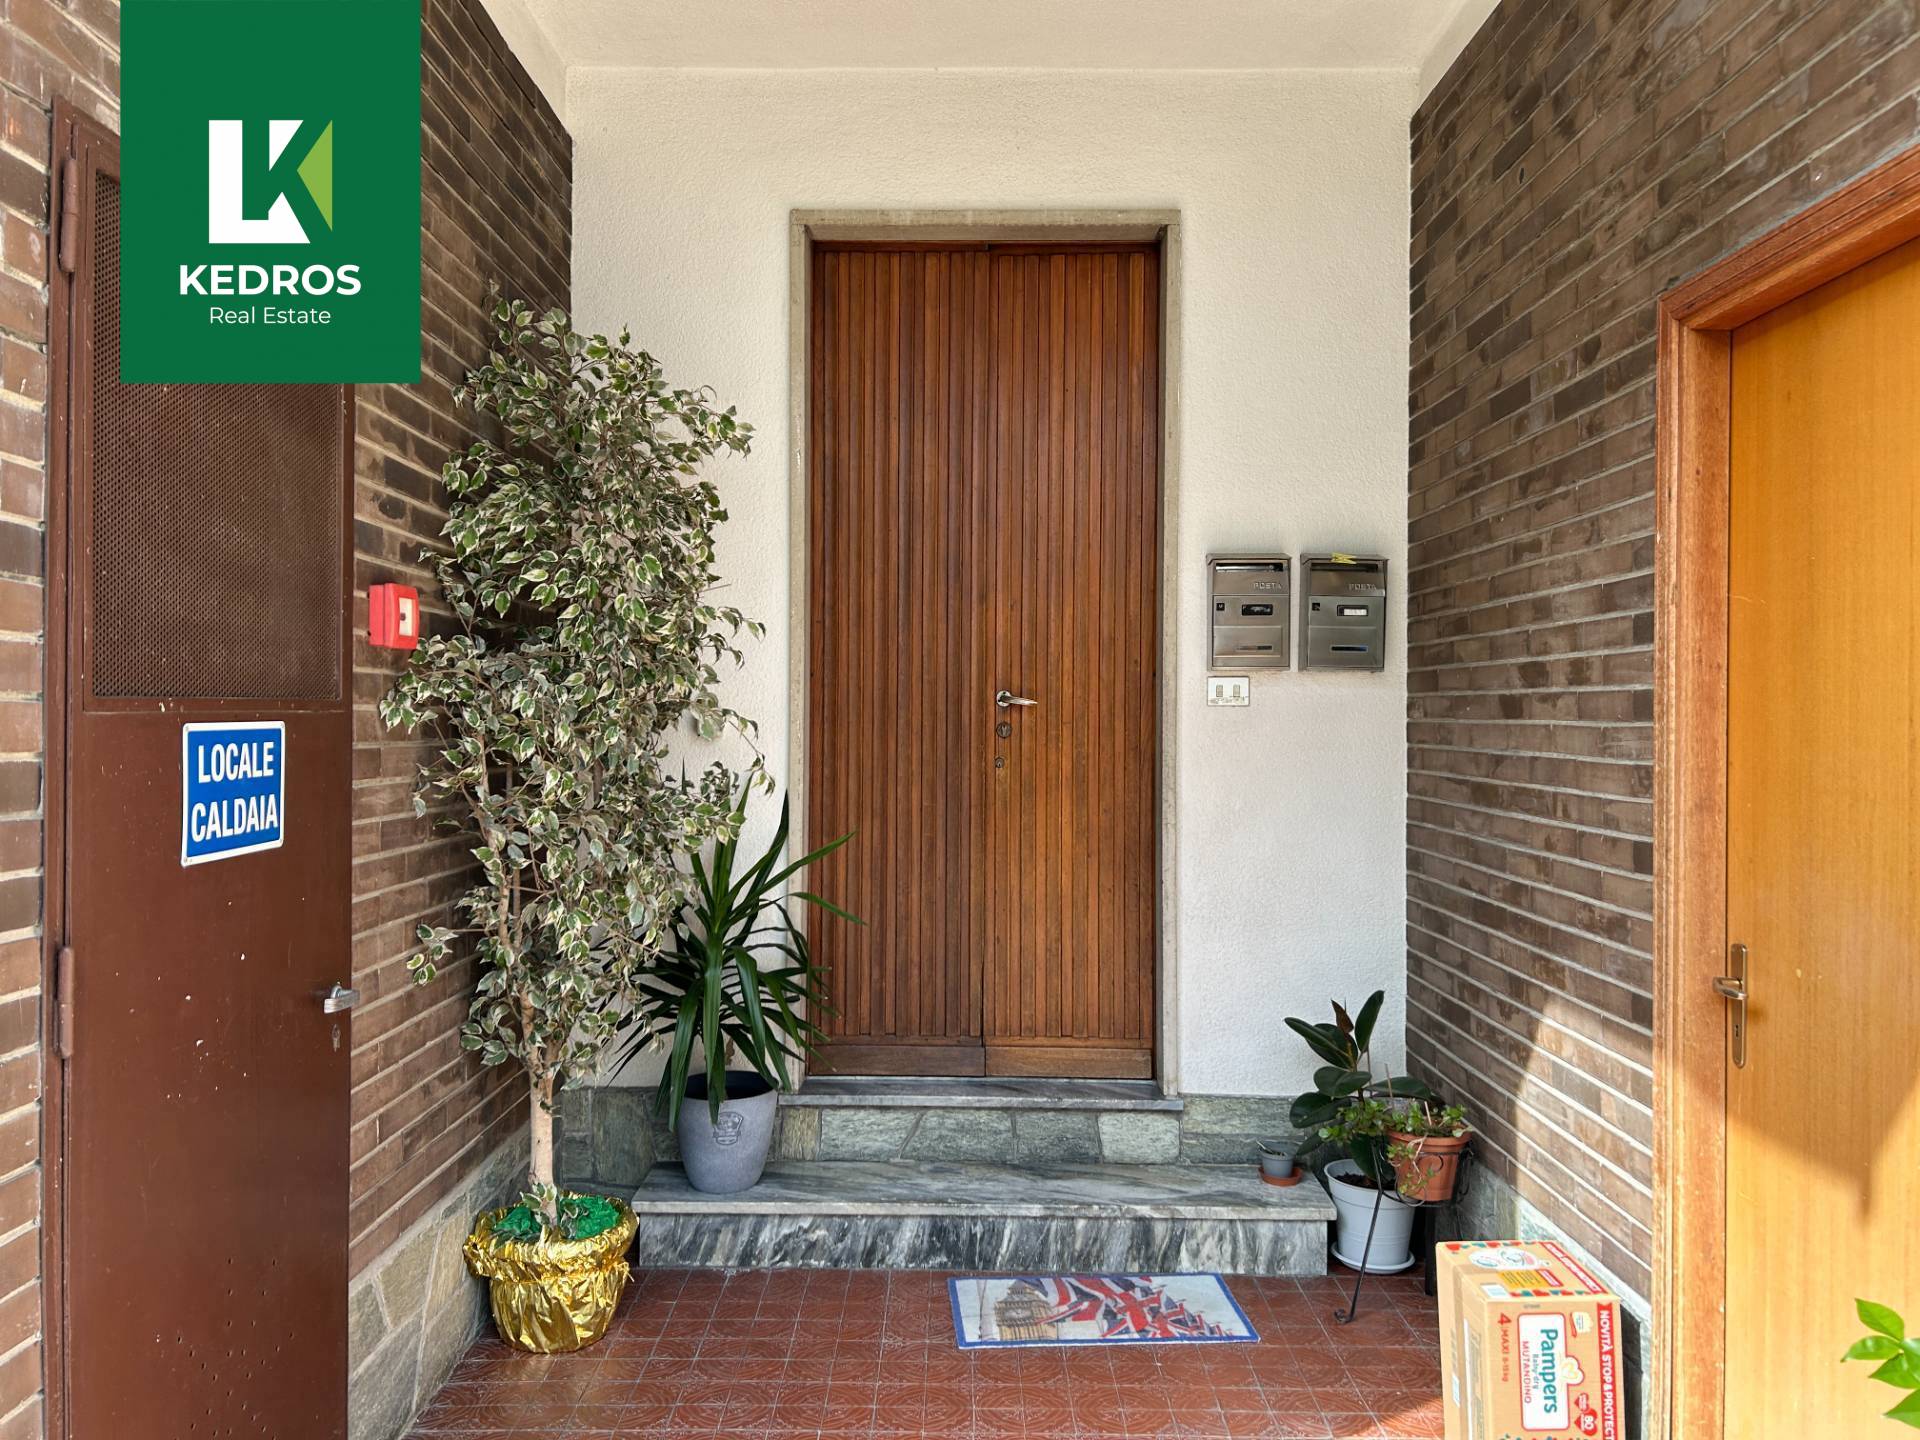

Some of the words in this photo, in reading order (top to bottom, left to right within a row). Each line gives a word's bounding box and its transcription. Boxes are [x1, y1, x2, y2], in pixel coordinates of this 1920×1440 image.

[1253, 582, 1282, 590] POSTA
[198, 741, 275, 784] LOCALE
[191, 794, 278, 842] CALDAIA
[1497, 1312, 1512, 1326] 4
[1600, 1310, 1613, 1352] NOVITÀ
[1501, 1329, 1509, 1354] MAXI
[1522, 1340, 1532, 1404] MUTANDINO
[1540, 1328, 1559, 1414] Pampers
